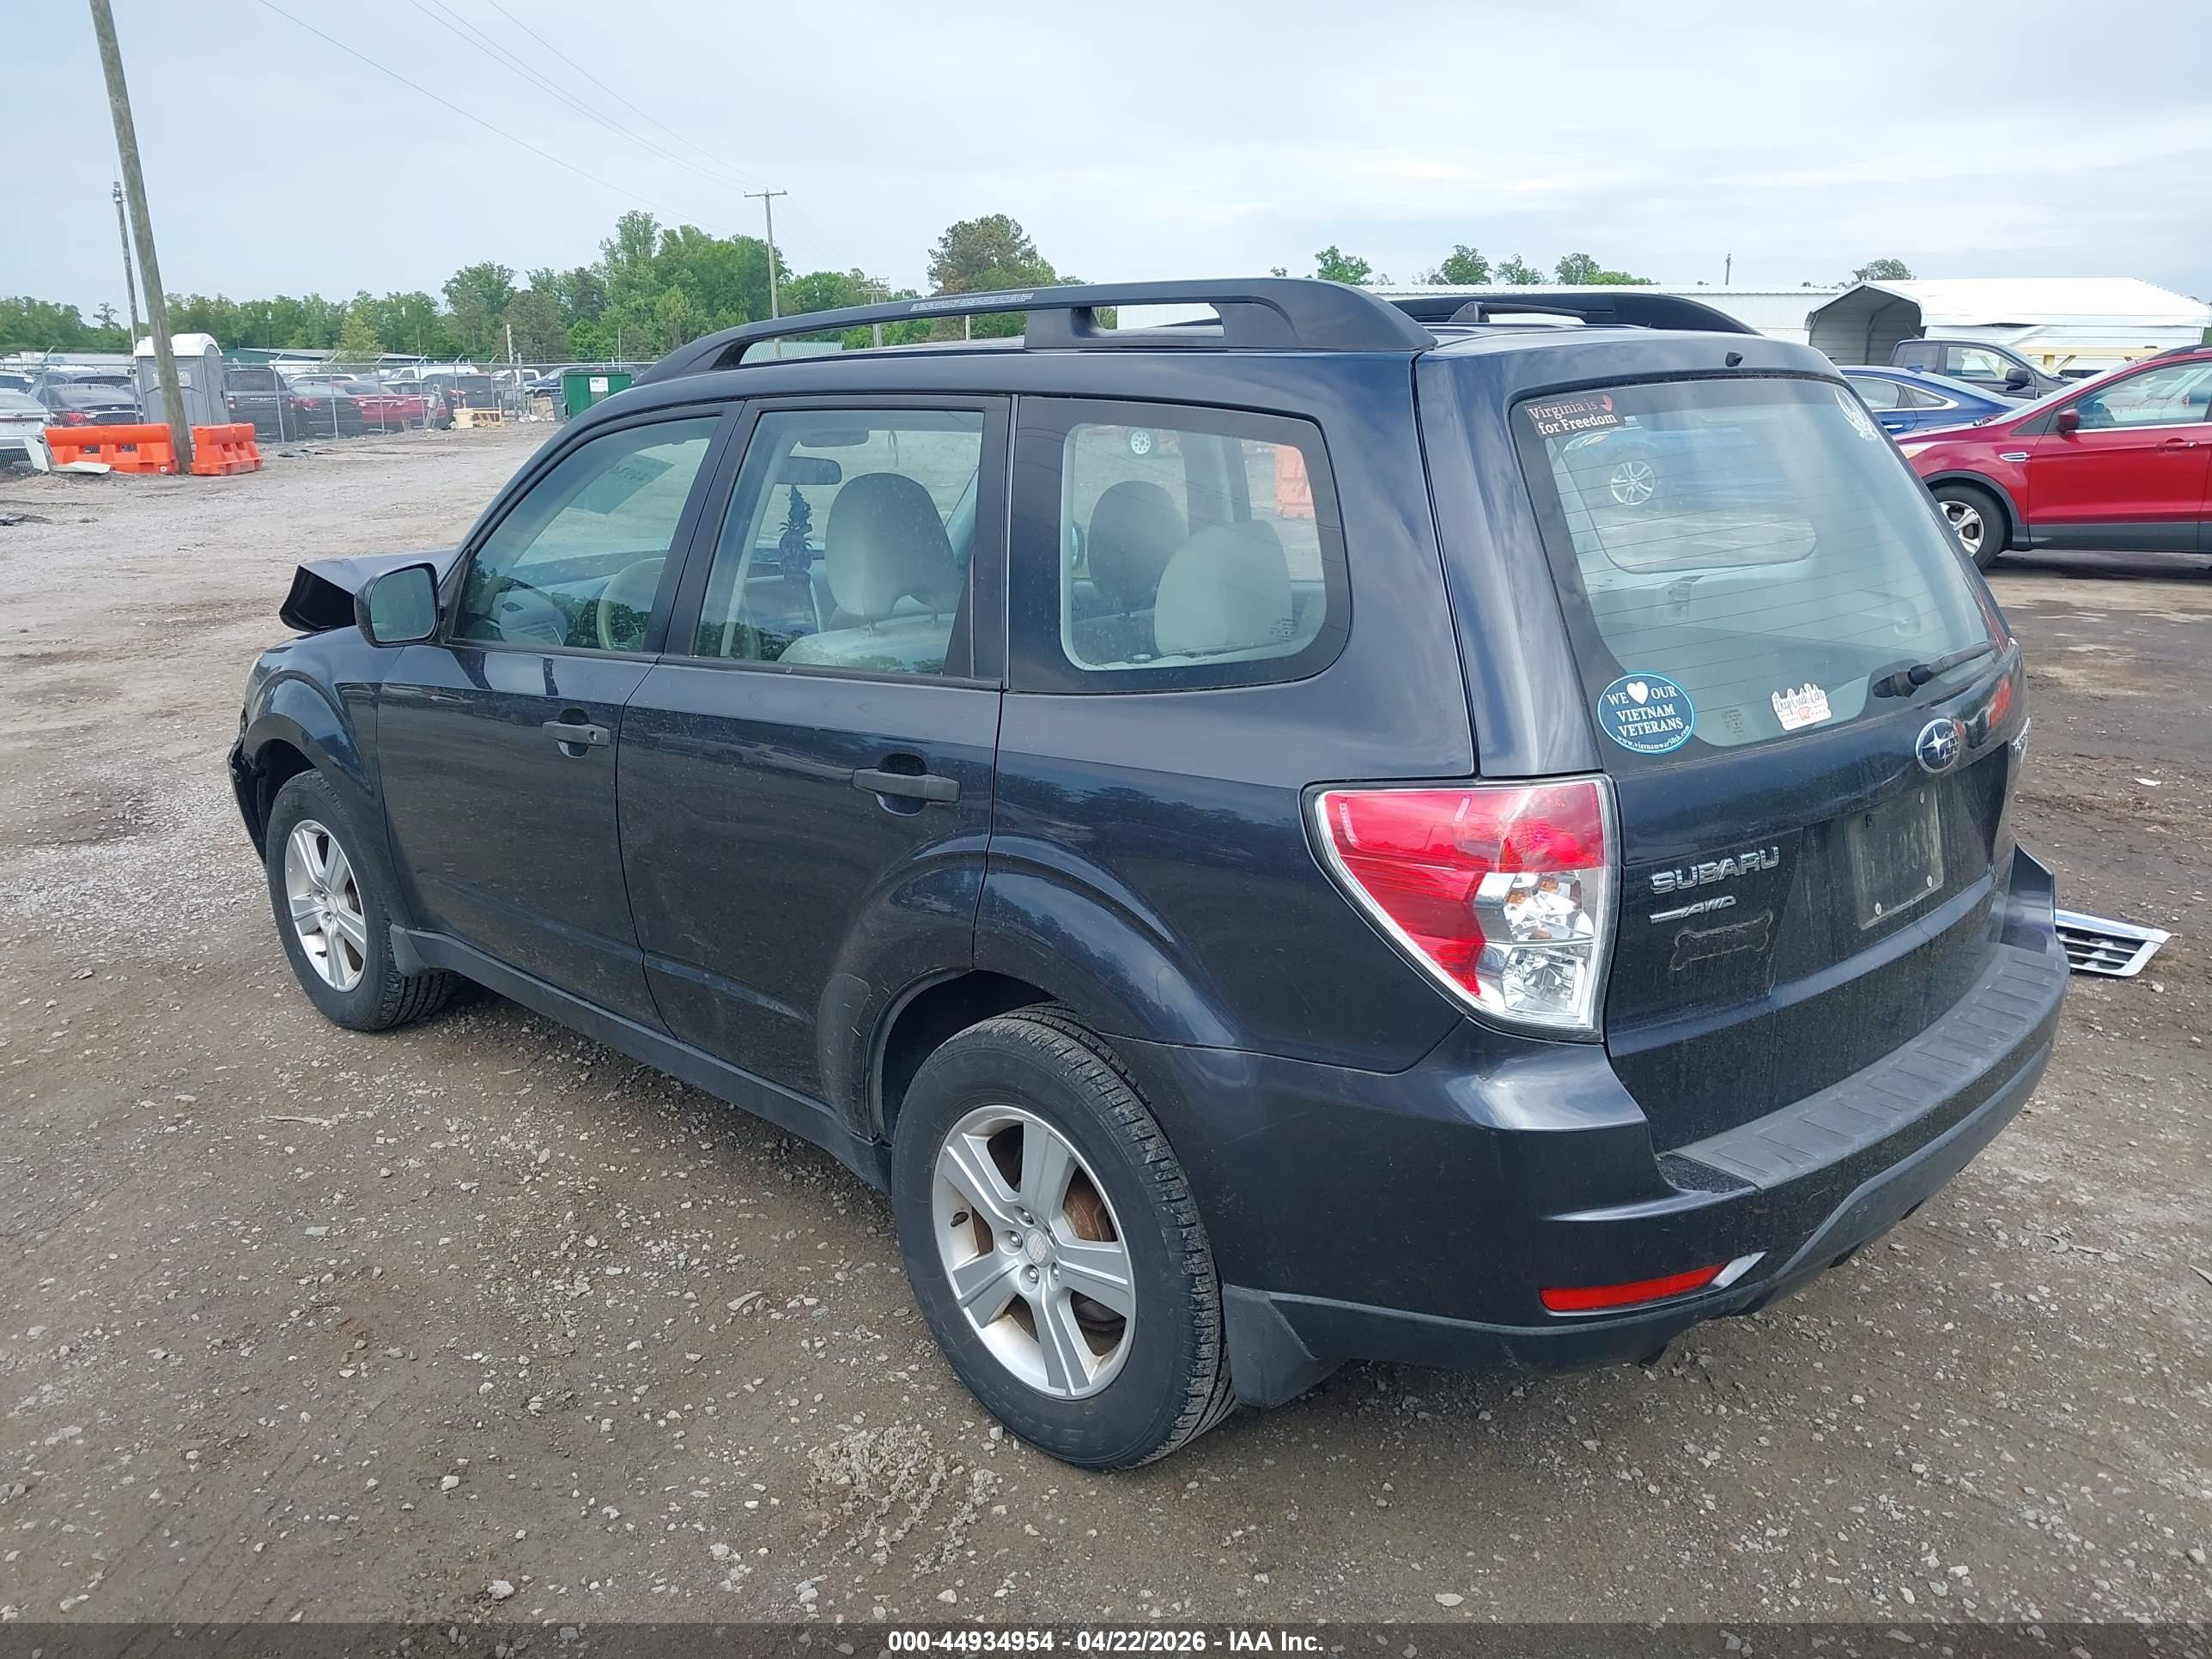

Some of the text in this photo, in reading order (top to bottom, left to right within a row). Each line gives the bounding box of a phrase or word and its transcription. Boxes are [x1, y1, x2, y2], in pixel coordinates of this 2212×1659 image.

[1528, 398, 1598, 420] Virginia is
[1538, 413, 1618, 434] for Freedom
[1606, 686, 1678, 707] WE OUR
[1616, 703, 1676, 723] VIETNAM
[1617, 725, 1691, 750] www.vietnamwar50th.com
[1618, 717, 1683, 738] VETERANS
[1650, 846, 1780, 895] SUBARU
[1684, 895, 1737, 917] AWD
